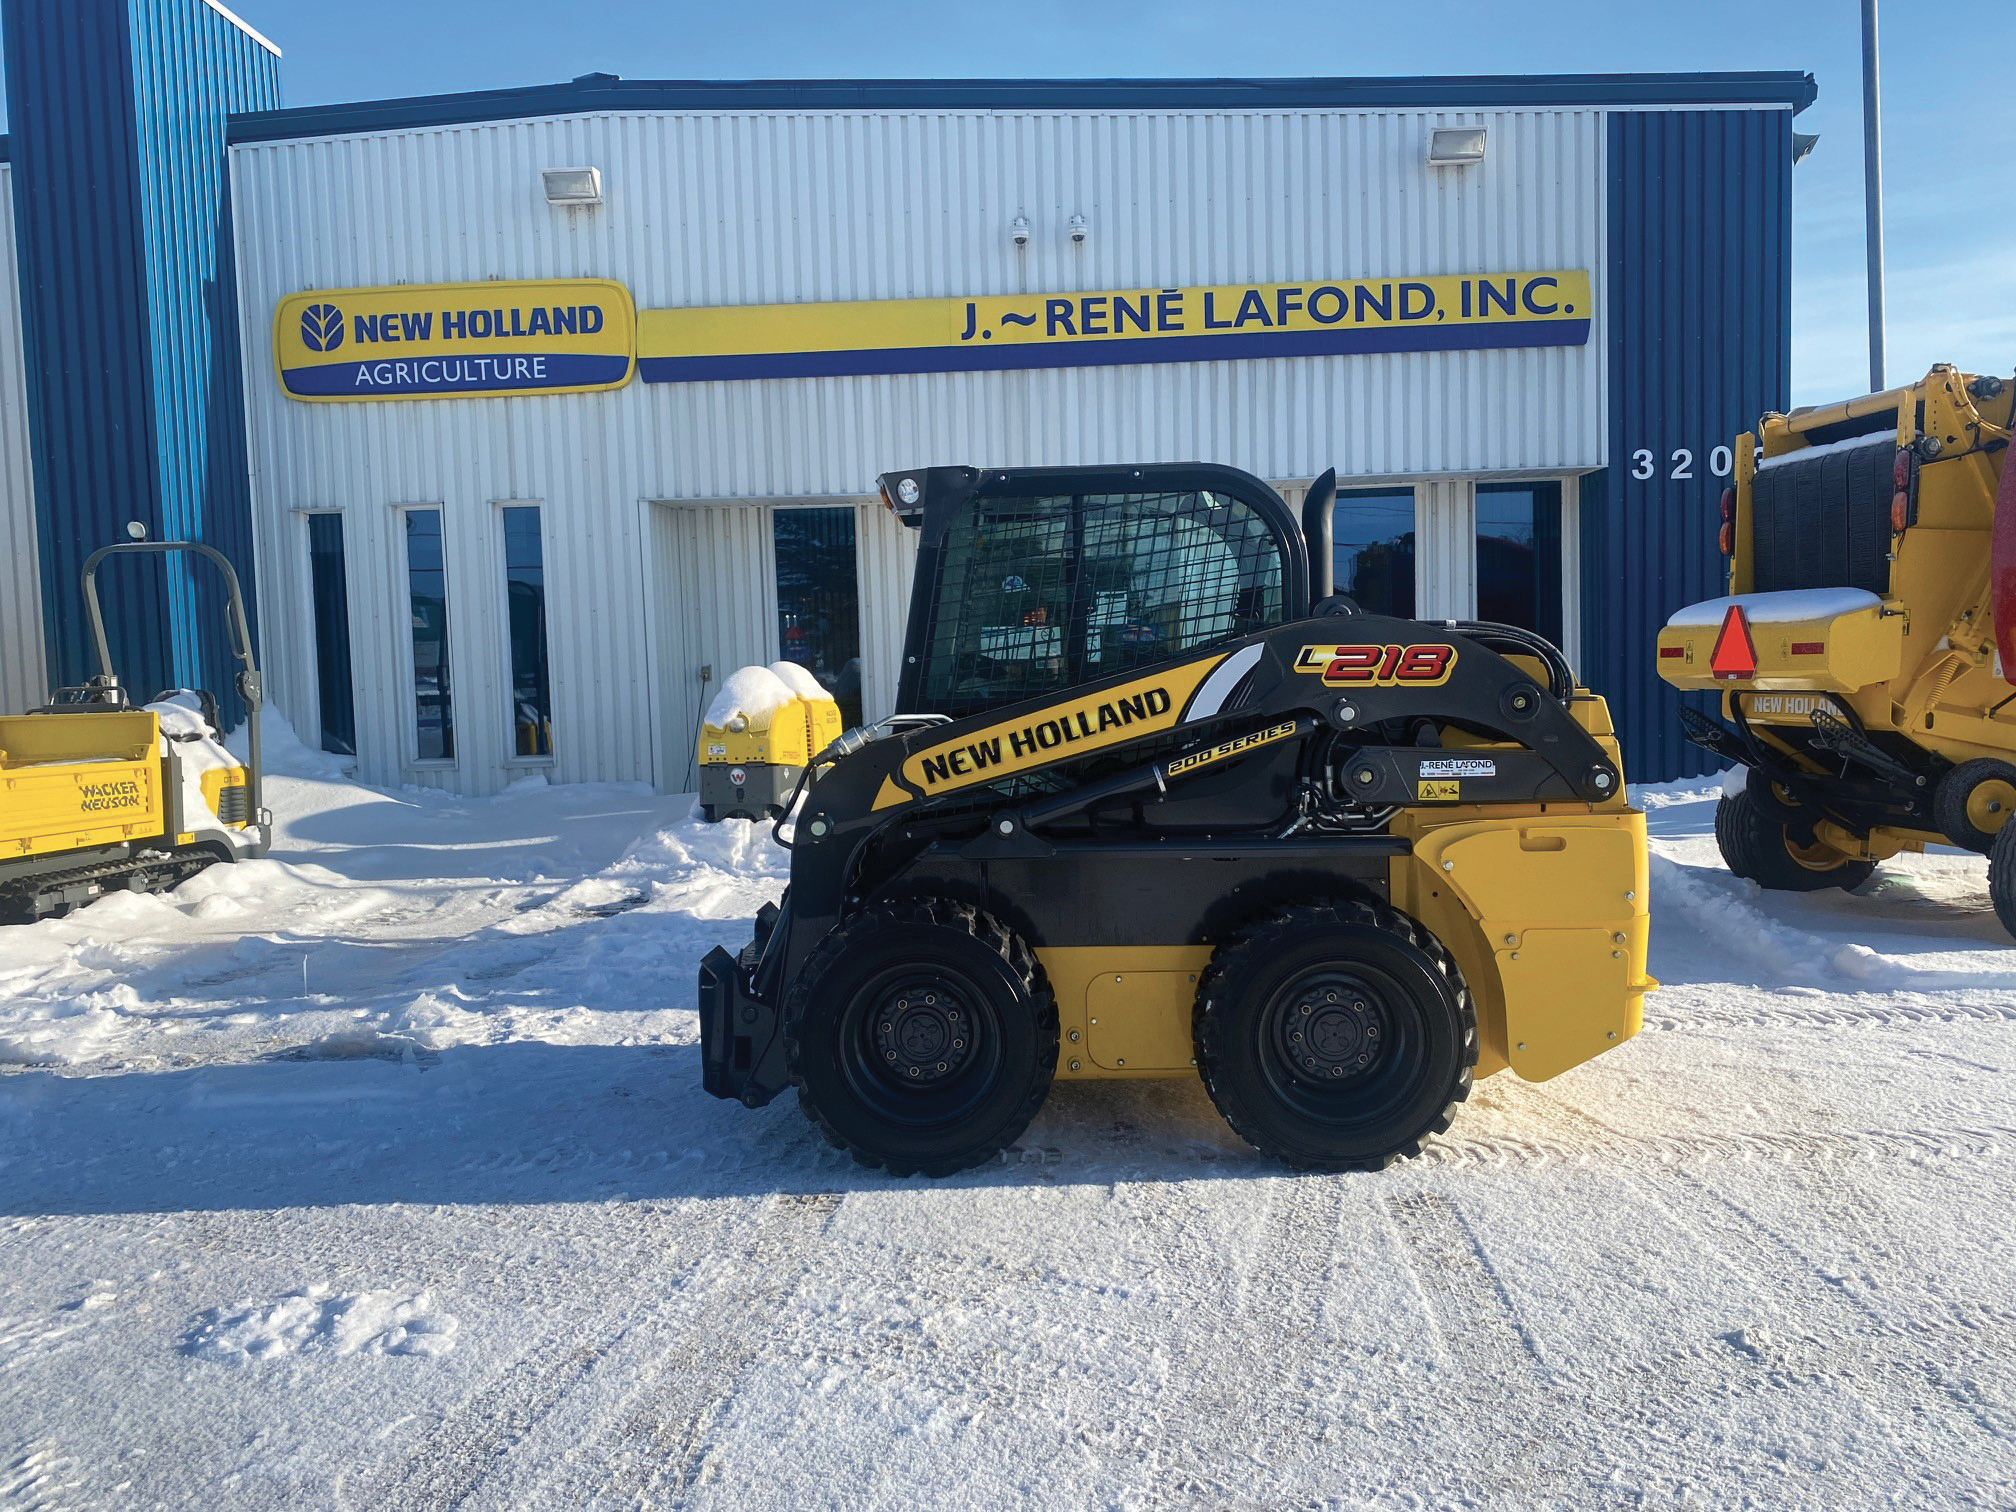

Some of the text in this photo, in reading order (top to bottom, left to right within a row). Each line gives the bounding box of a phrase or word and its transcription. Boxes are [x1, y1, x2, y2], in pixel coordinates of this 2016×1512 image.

[1203, 282, 1446, 329] LAFOND,
[1461, 276, 1576, 318] INC.
[354, 305, 604, 343] NEW HOLLAND
[354, 357, 547, 386] AGRICULTURE
[1296, 646, 1454, 681] L218
[1754, 697, 1782, 713] NEW
[920, 687, 1171, 784] NEW HOLLAND
[1169, 721, 1294, 774] 200 SERIES
[78, 781, 139, 798] WACKER
[81, 794, 139, 812] NEUSON
